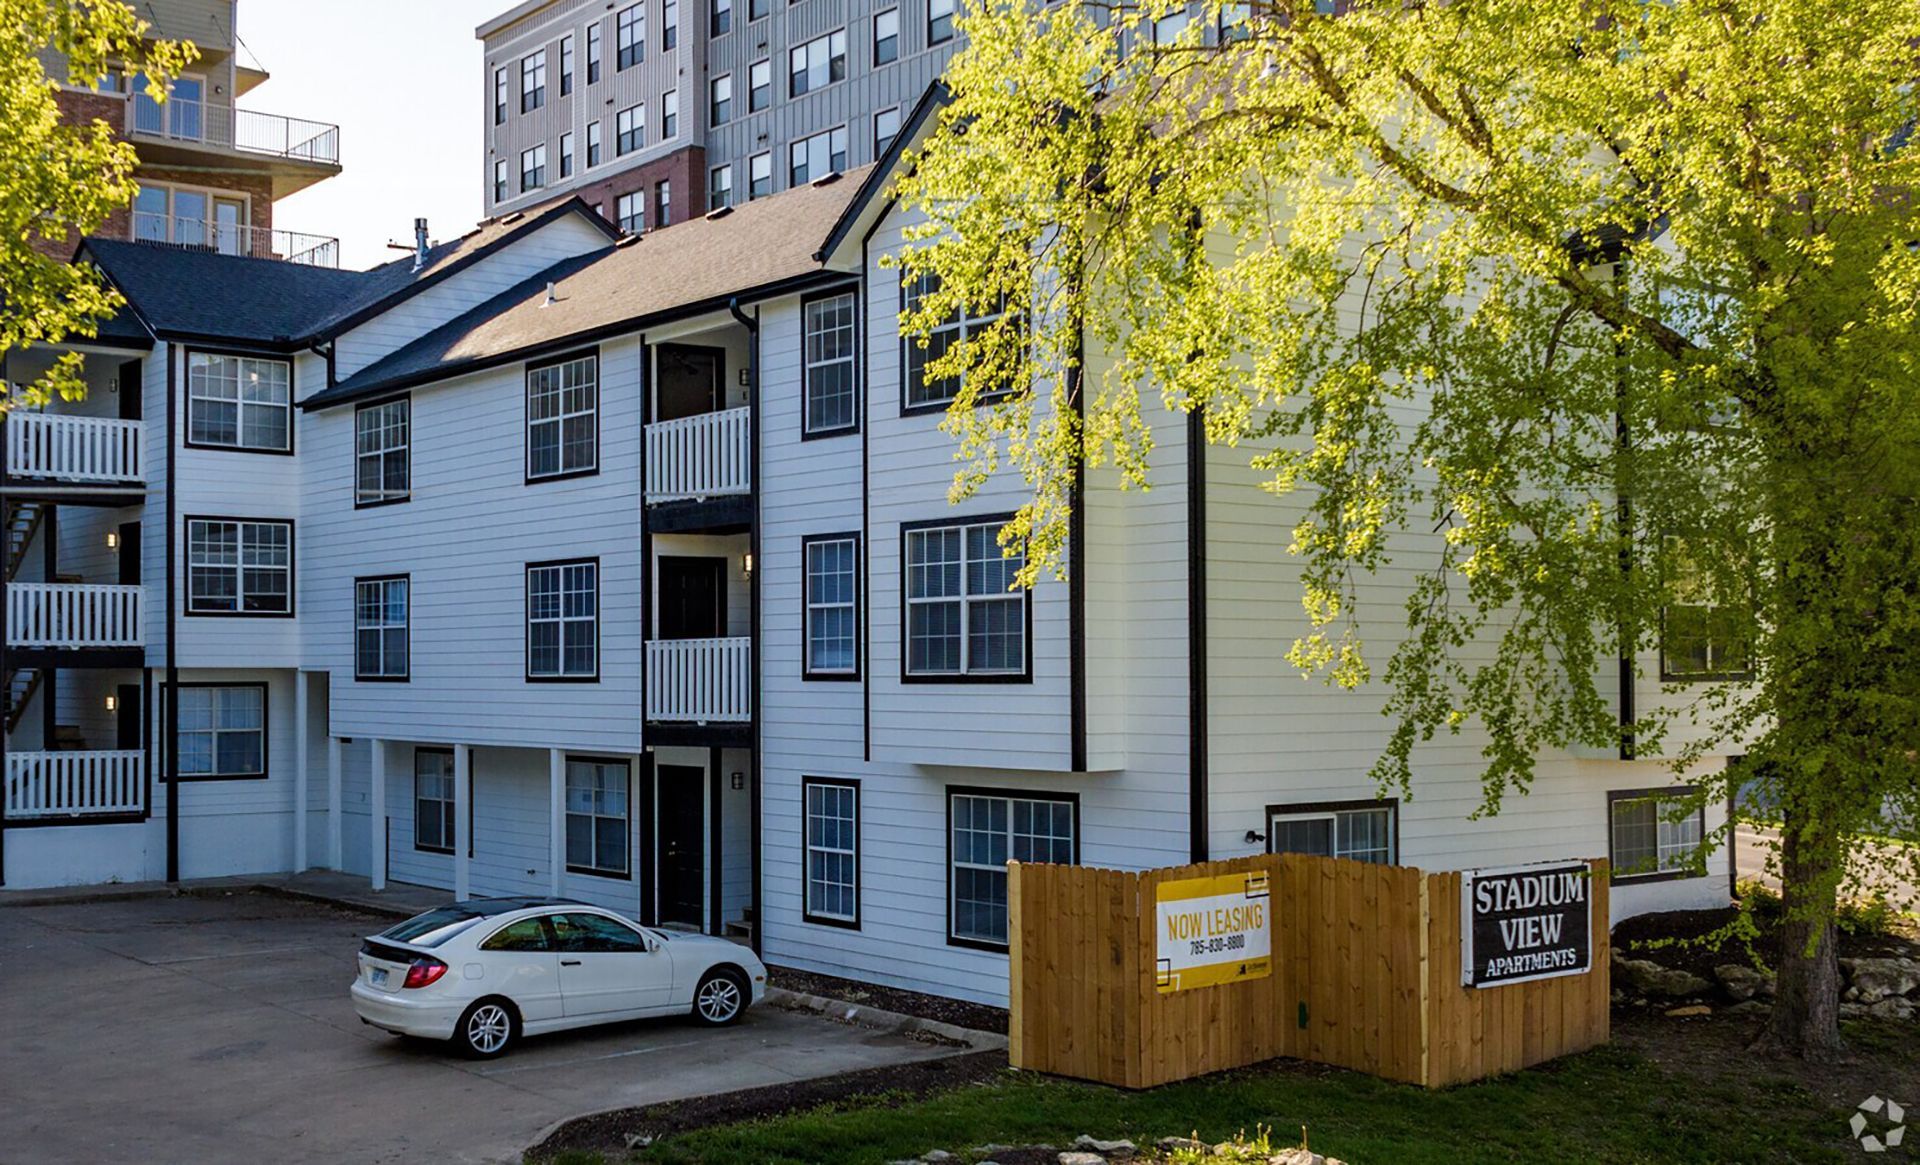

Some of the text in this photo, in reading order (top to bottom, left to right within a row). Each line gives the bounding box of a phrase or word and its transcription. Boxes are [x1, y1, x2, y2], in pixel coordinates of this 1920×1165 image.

[1476, 873, 1584, 914] STADIUM
[1168, 904, 1263, 941] NOW LEASING
[1499, 913, 1564, 951] VIEW
[1485, 948, 1576, 977] APARTMENTS
